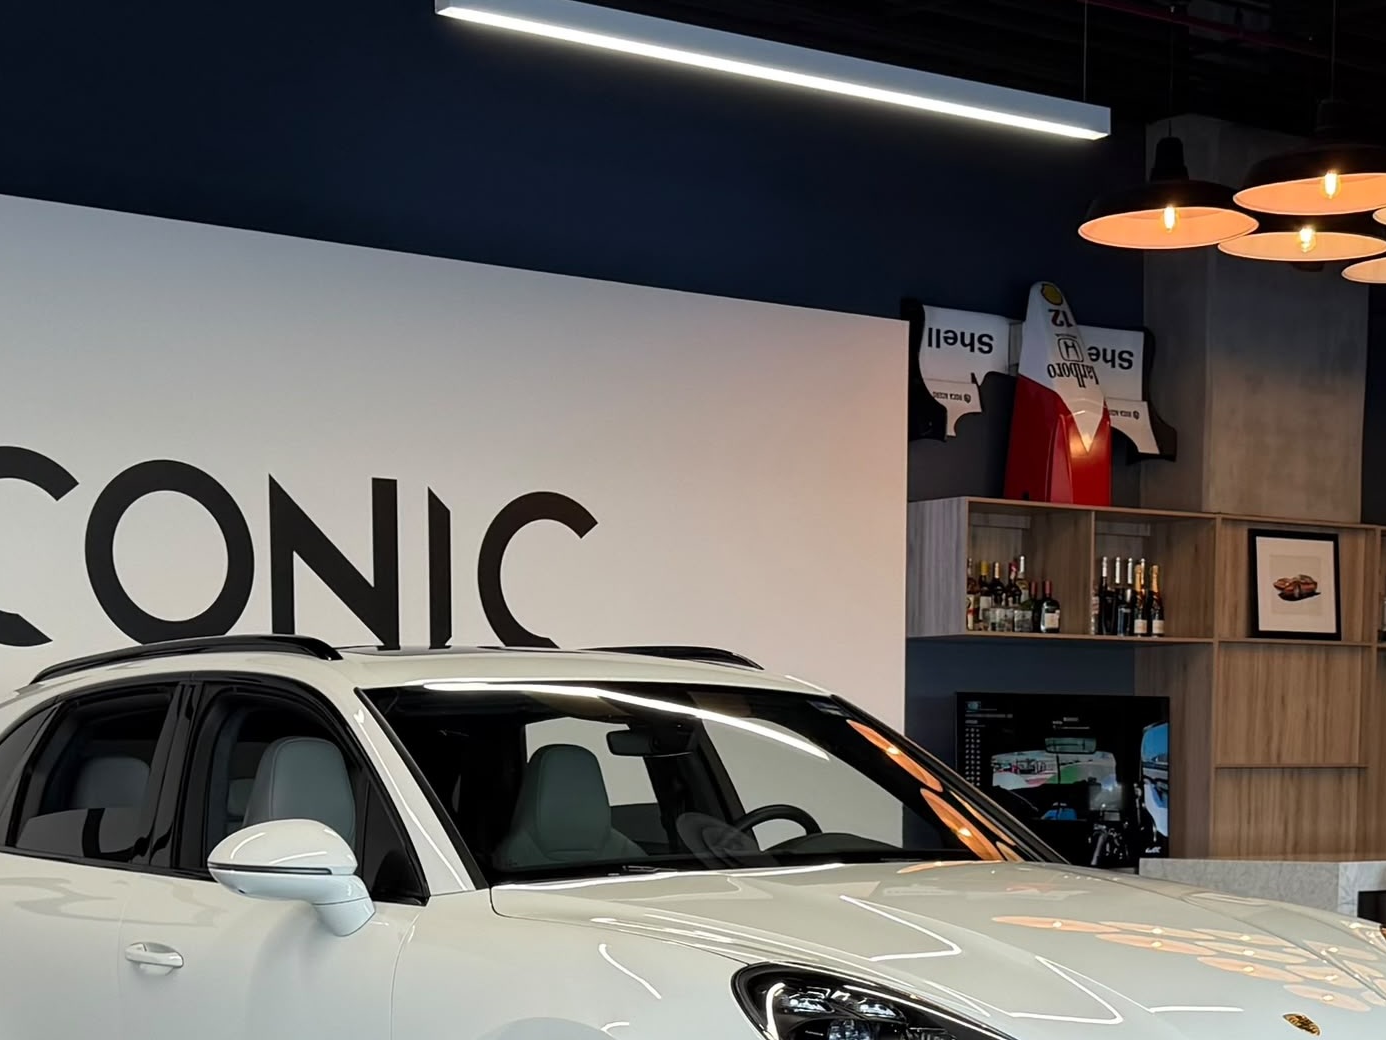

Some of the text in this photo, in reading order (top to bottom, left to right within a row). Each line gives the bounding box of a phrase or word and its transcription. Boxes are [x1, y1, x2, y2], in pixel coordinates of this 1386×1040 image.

[1048, 308, 1074, 328] 12
[927, 327, 994, 354] Shell
[1087, 346, 1135, 371] She
